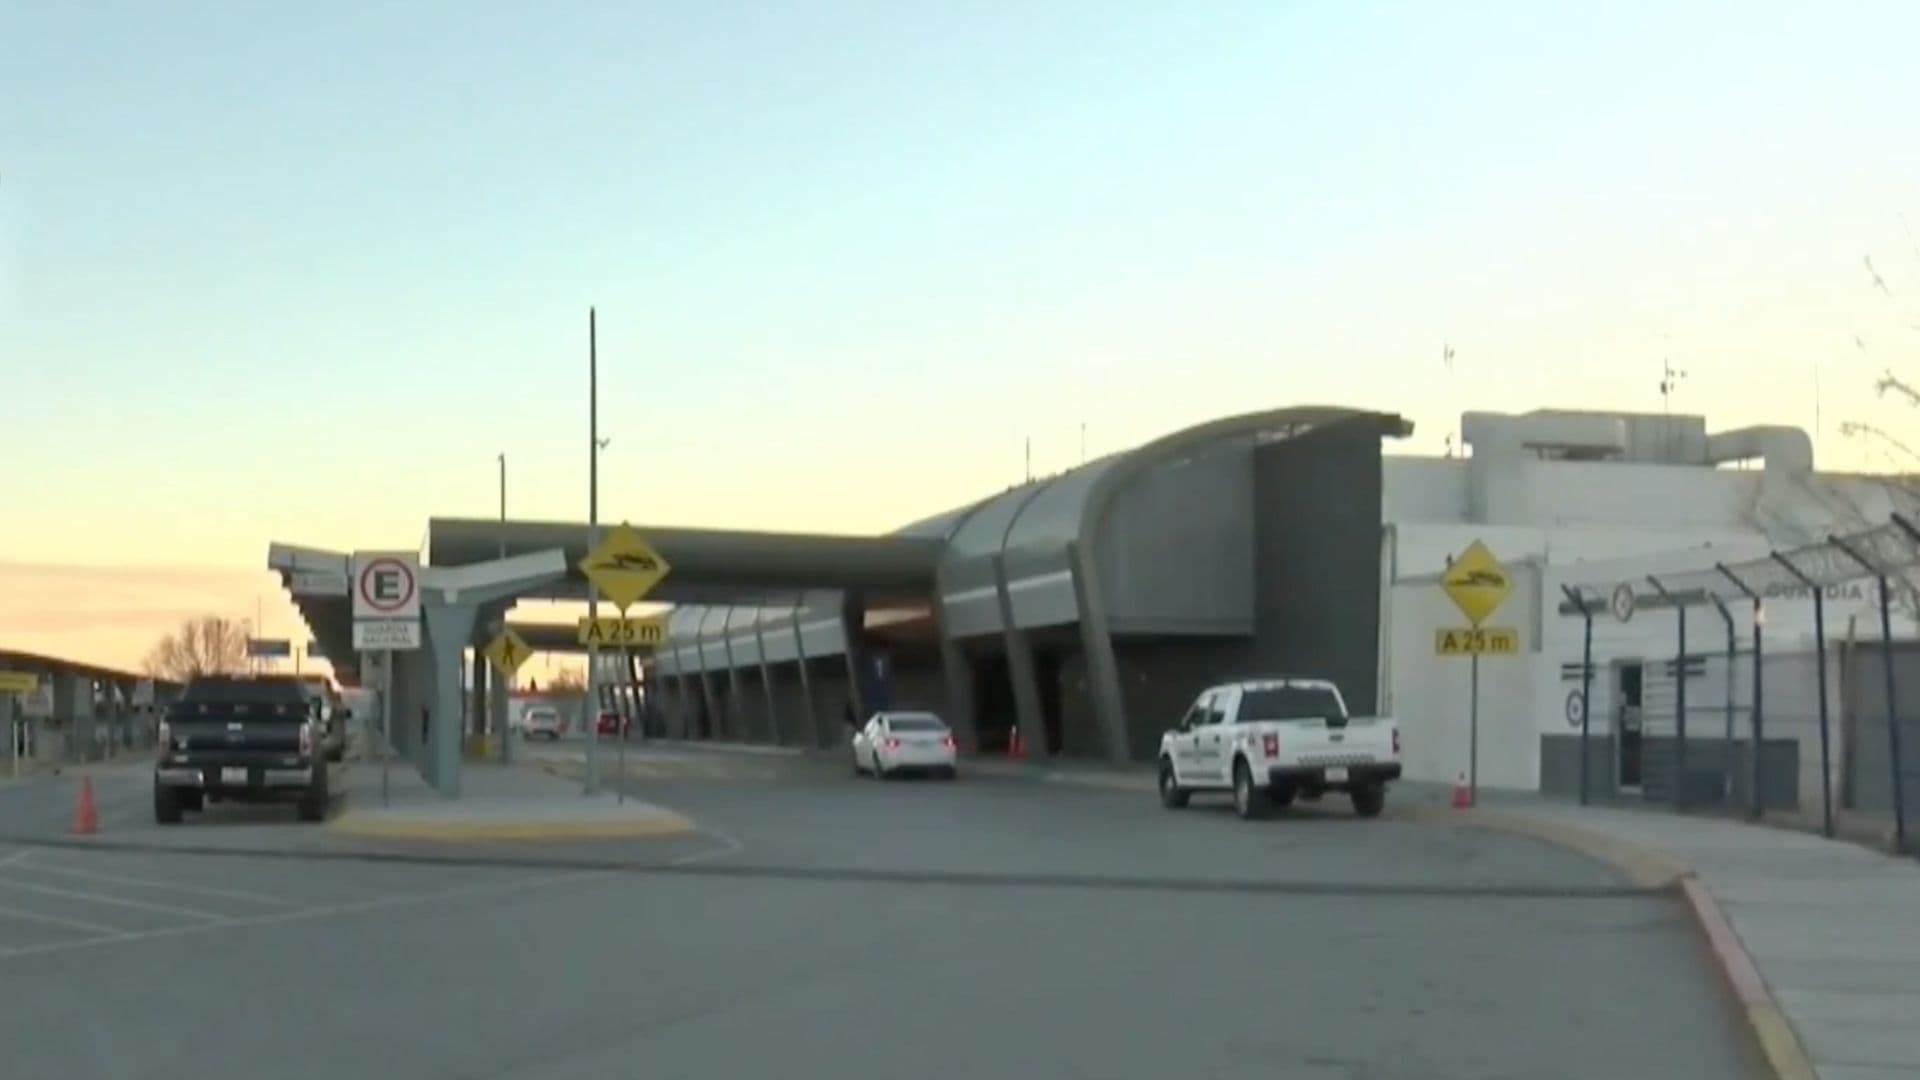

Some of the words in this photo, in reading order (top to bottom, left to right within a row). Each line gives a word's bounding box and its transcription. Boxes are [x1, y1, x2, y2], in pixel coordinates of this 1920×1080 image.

[374, 571, 400, 600] E
[1764, 581, 1863, 599] GUADIA
[588, 621, 602, 640] A
[610, 620, 634, 640] 25
[641, 625, 661, 640] m
[1444, 630, 1458, 651] A
[1463, 630, 1485, 651] 25
[1491, 635, 1510, 651] m
